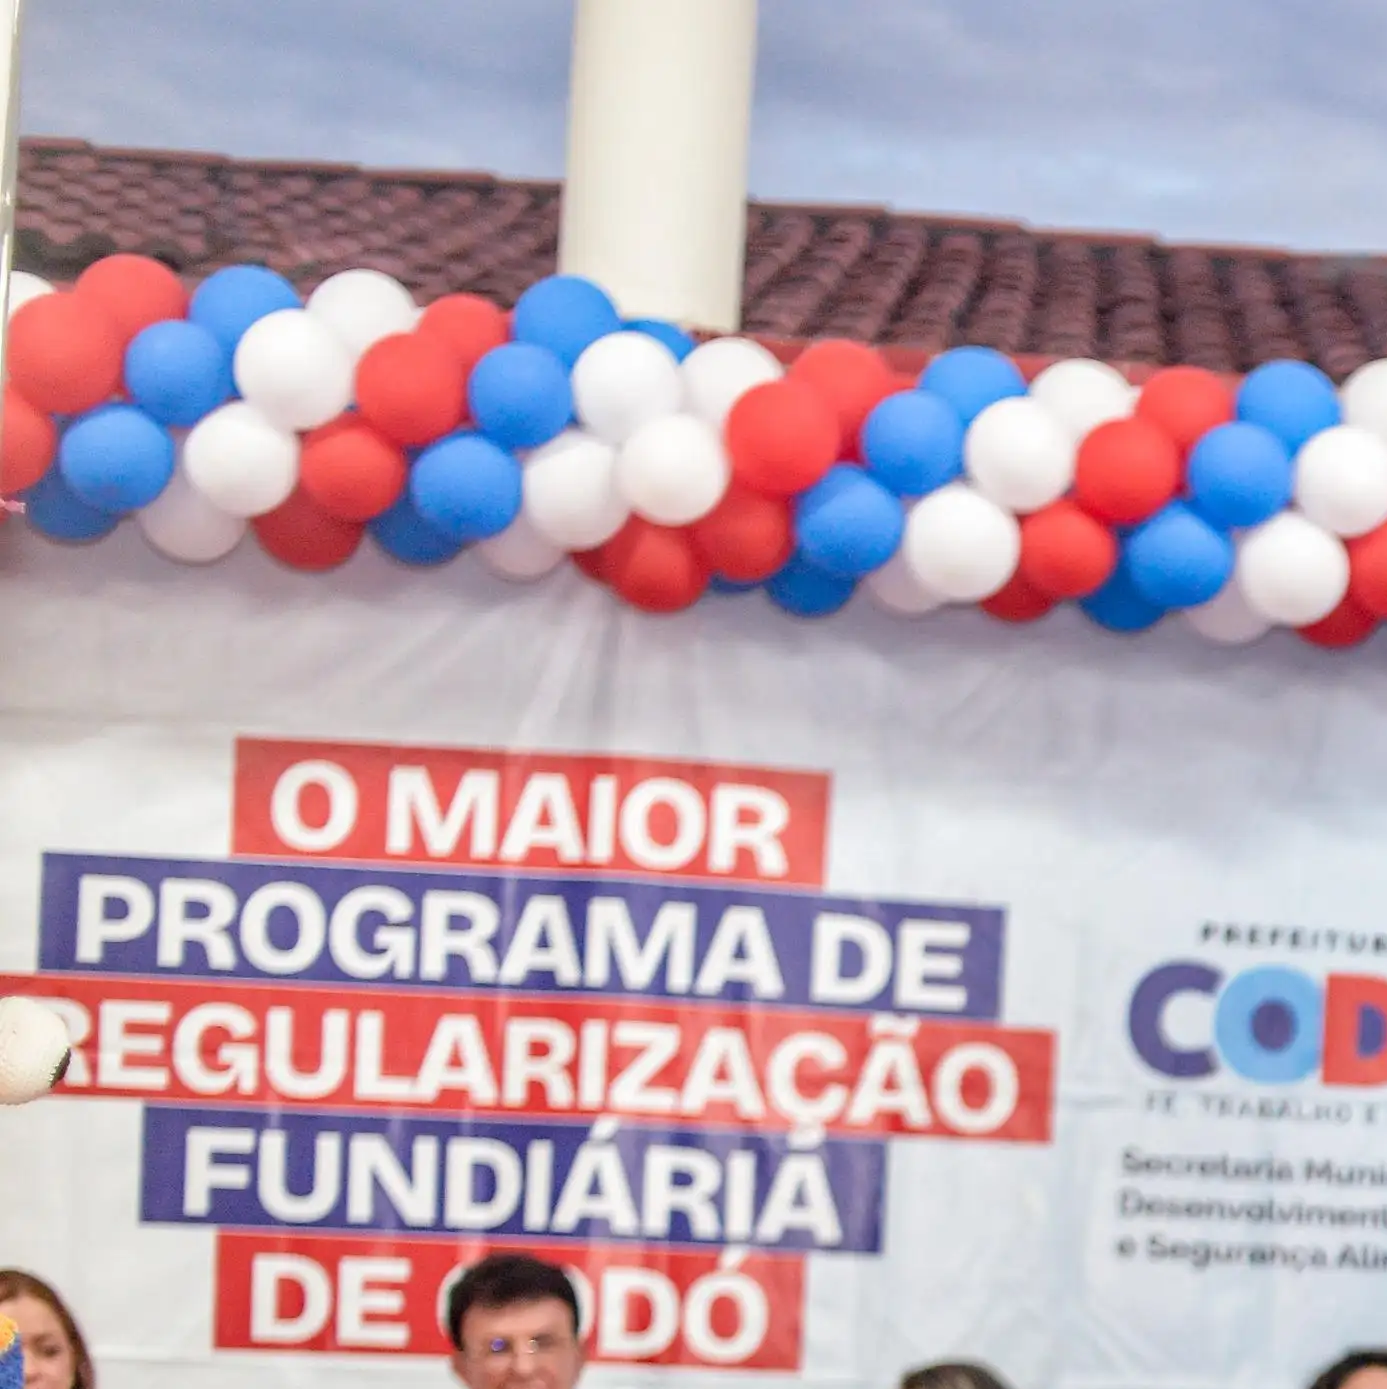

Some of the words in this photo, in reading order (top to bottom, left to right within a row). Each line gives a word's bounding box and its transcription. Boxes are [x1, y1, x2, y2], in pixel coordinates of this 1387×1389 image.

[271, 760, 357, 852] O
[385, 769, 789, 878] MAIOR
[75, 874, 784, 998] PROGRAMA
[810, 913, 971, 1011] DE
[1121, 1147, 1293, 1182] Secretaria
[1115, 1239, 1137, 1259] e
[1147, 1236, 1326, 1270] Segurança
[249, 1255, 411, 1349] DE
